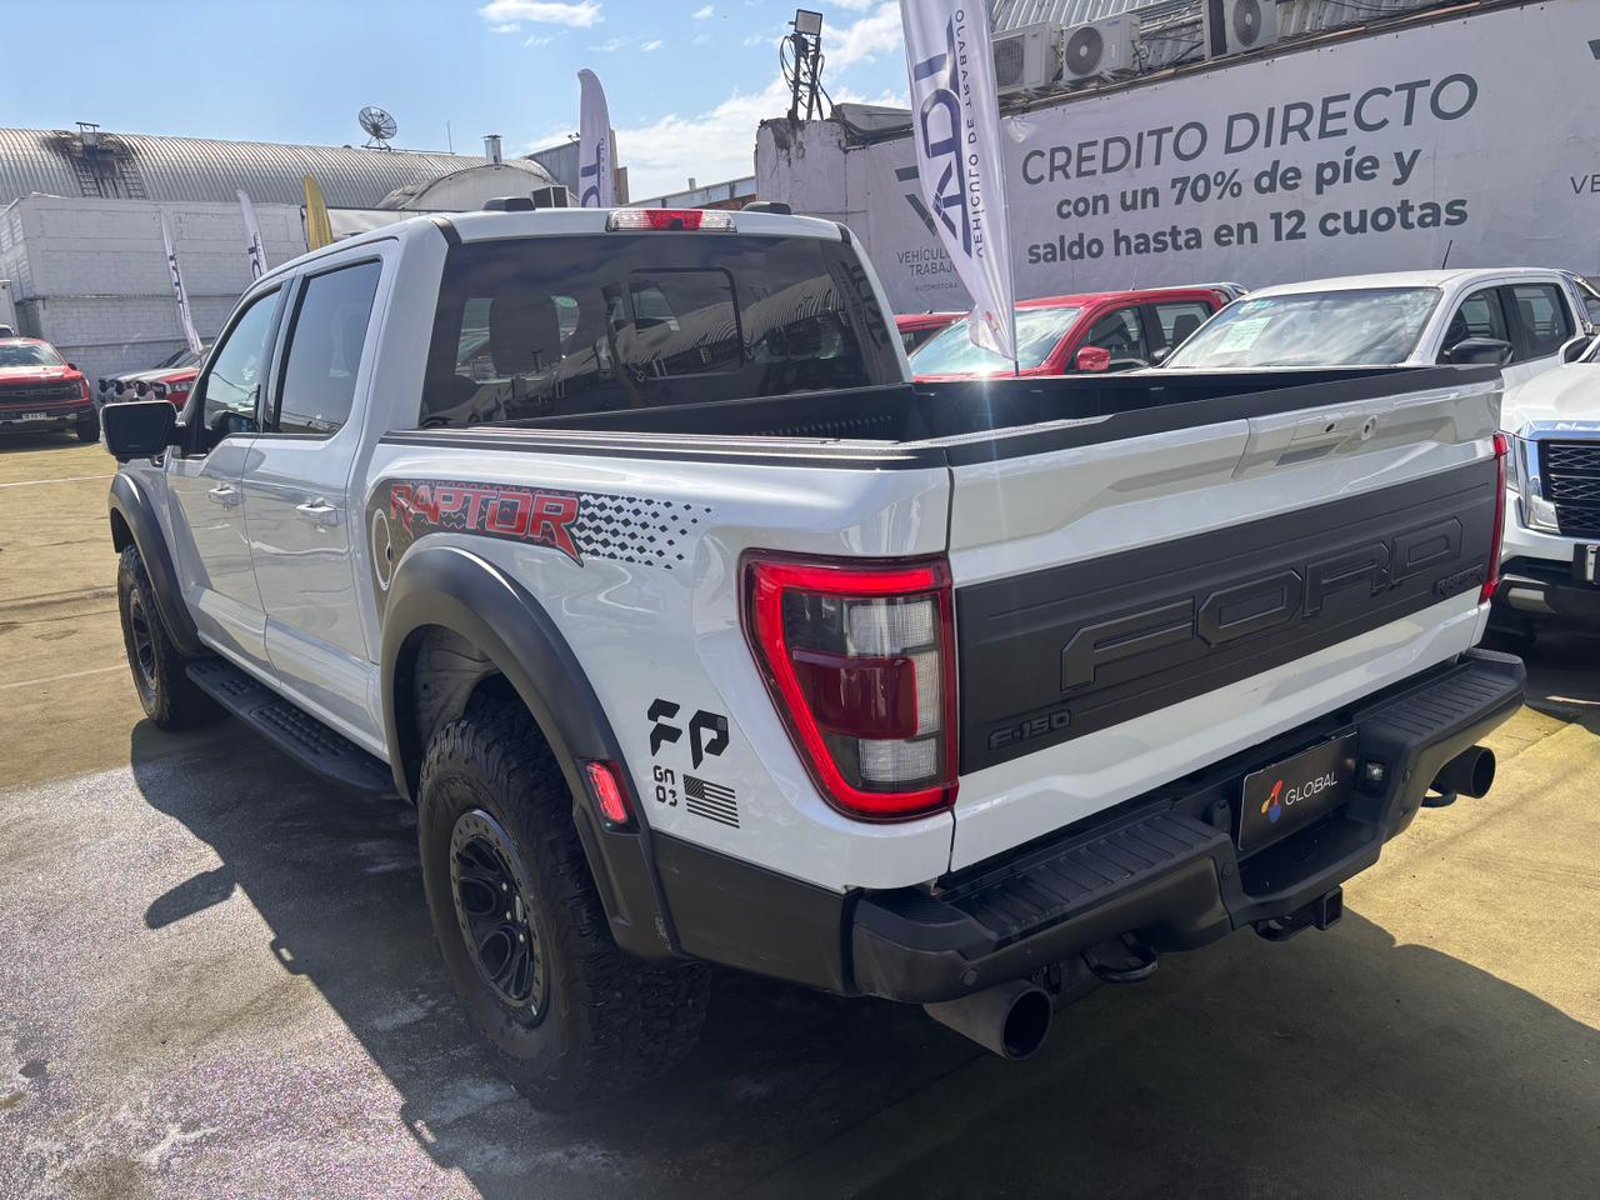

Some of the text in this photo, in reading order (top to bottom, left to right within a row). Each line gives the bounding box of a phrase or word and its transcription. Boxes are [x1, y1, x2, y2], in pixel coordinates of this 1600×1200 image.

[1022, 73, 1478, 185] CREDITO DIRECTO
[1056, 146, 1423, 219] con un 70% de píe y
[896, 246, 950, 264] VEHÍCUL
[1028, 199, 1468, 264] saldo hasta en 12 cuotas
[909, 261, 956, 276] TRABAJ
[390, 484, 584, 567] RAPTOR
[1061, 516, 1463, 691] FORD
[988, 709, 1072, 751] F-150
[1285, 771, 1338, 805] GLOBAL
